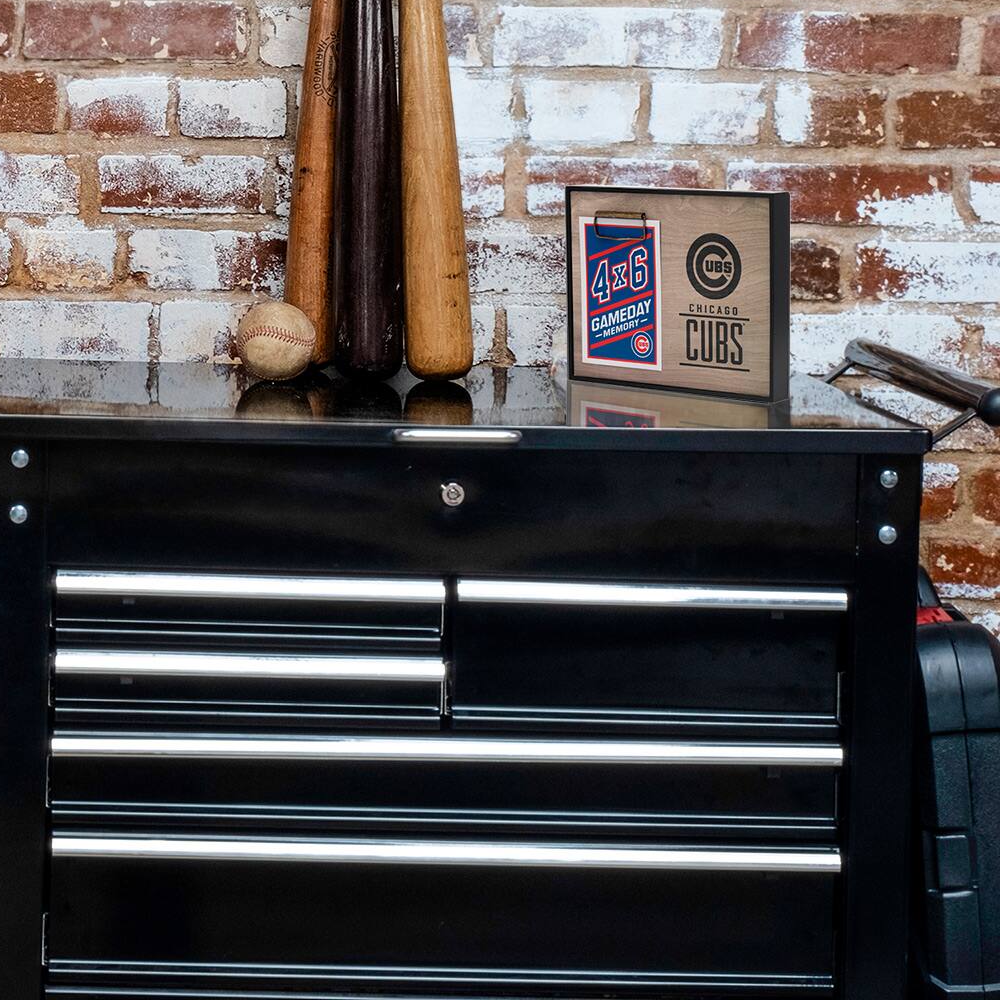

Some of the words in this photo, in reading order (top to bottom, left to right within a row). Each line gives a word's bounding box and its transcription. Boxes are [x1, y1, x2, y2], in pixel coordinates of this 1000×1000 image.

[695, 245, 732, 288] CUBS
[591, 298, 652, 332] GAMEDAY
[689, 303, 739, 316] CHICAGO
[603, 318, 640, 338] MEMORY
[686, 318, 743, 365] CUBS
